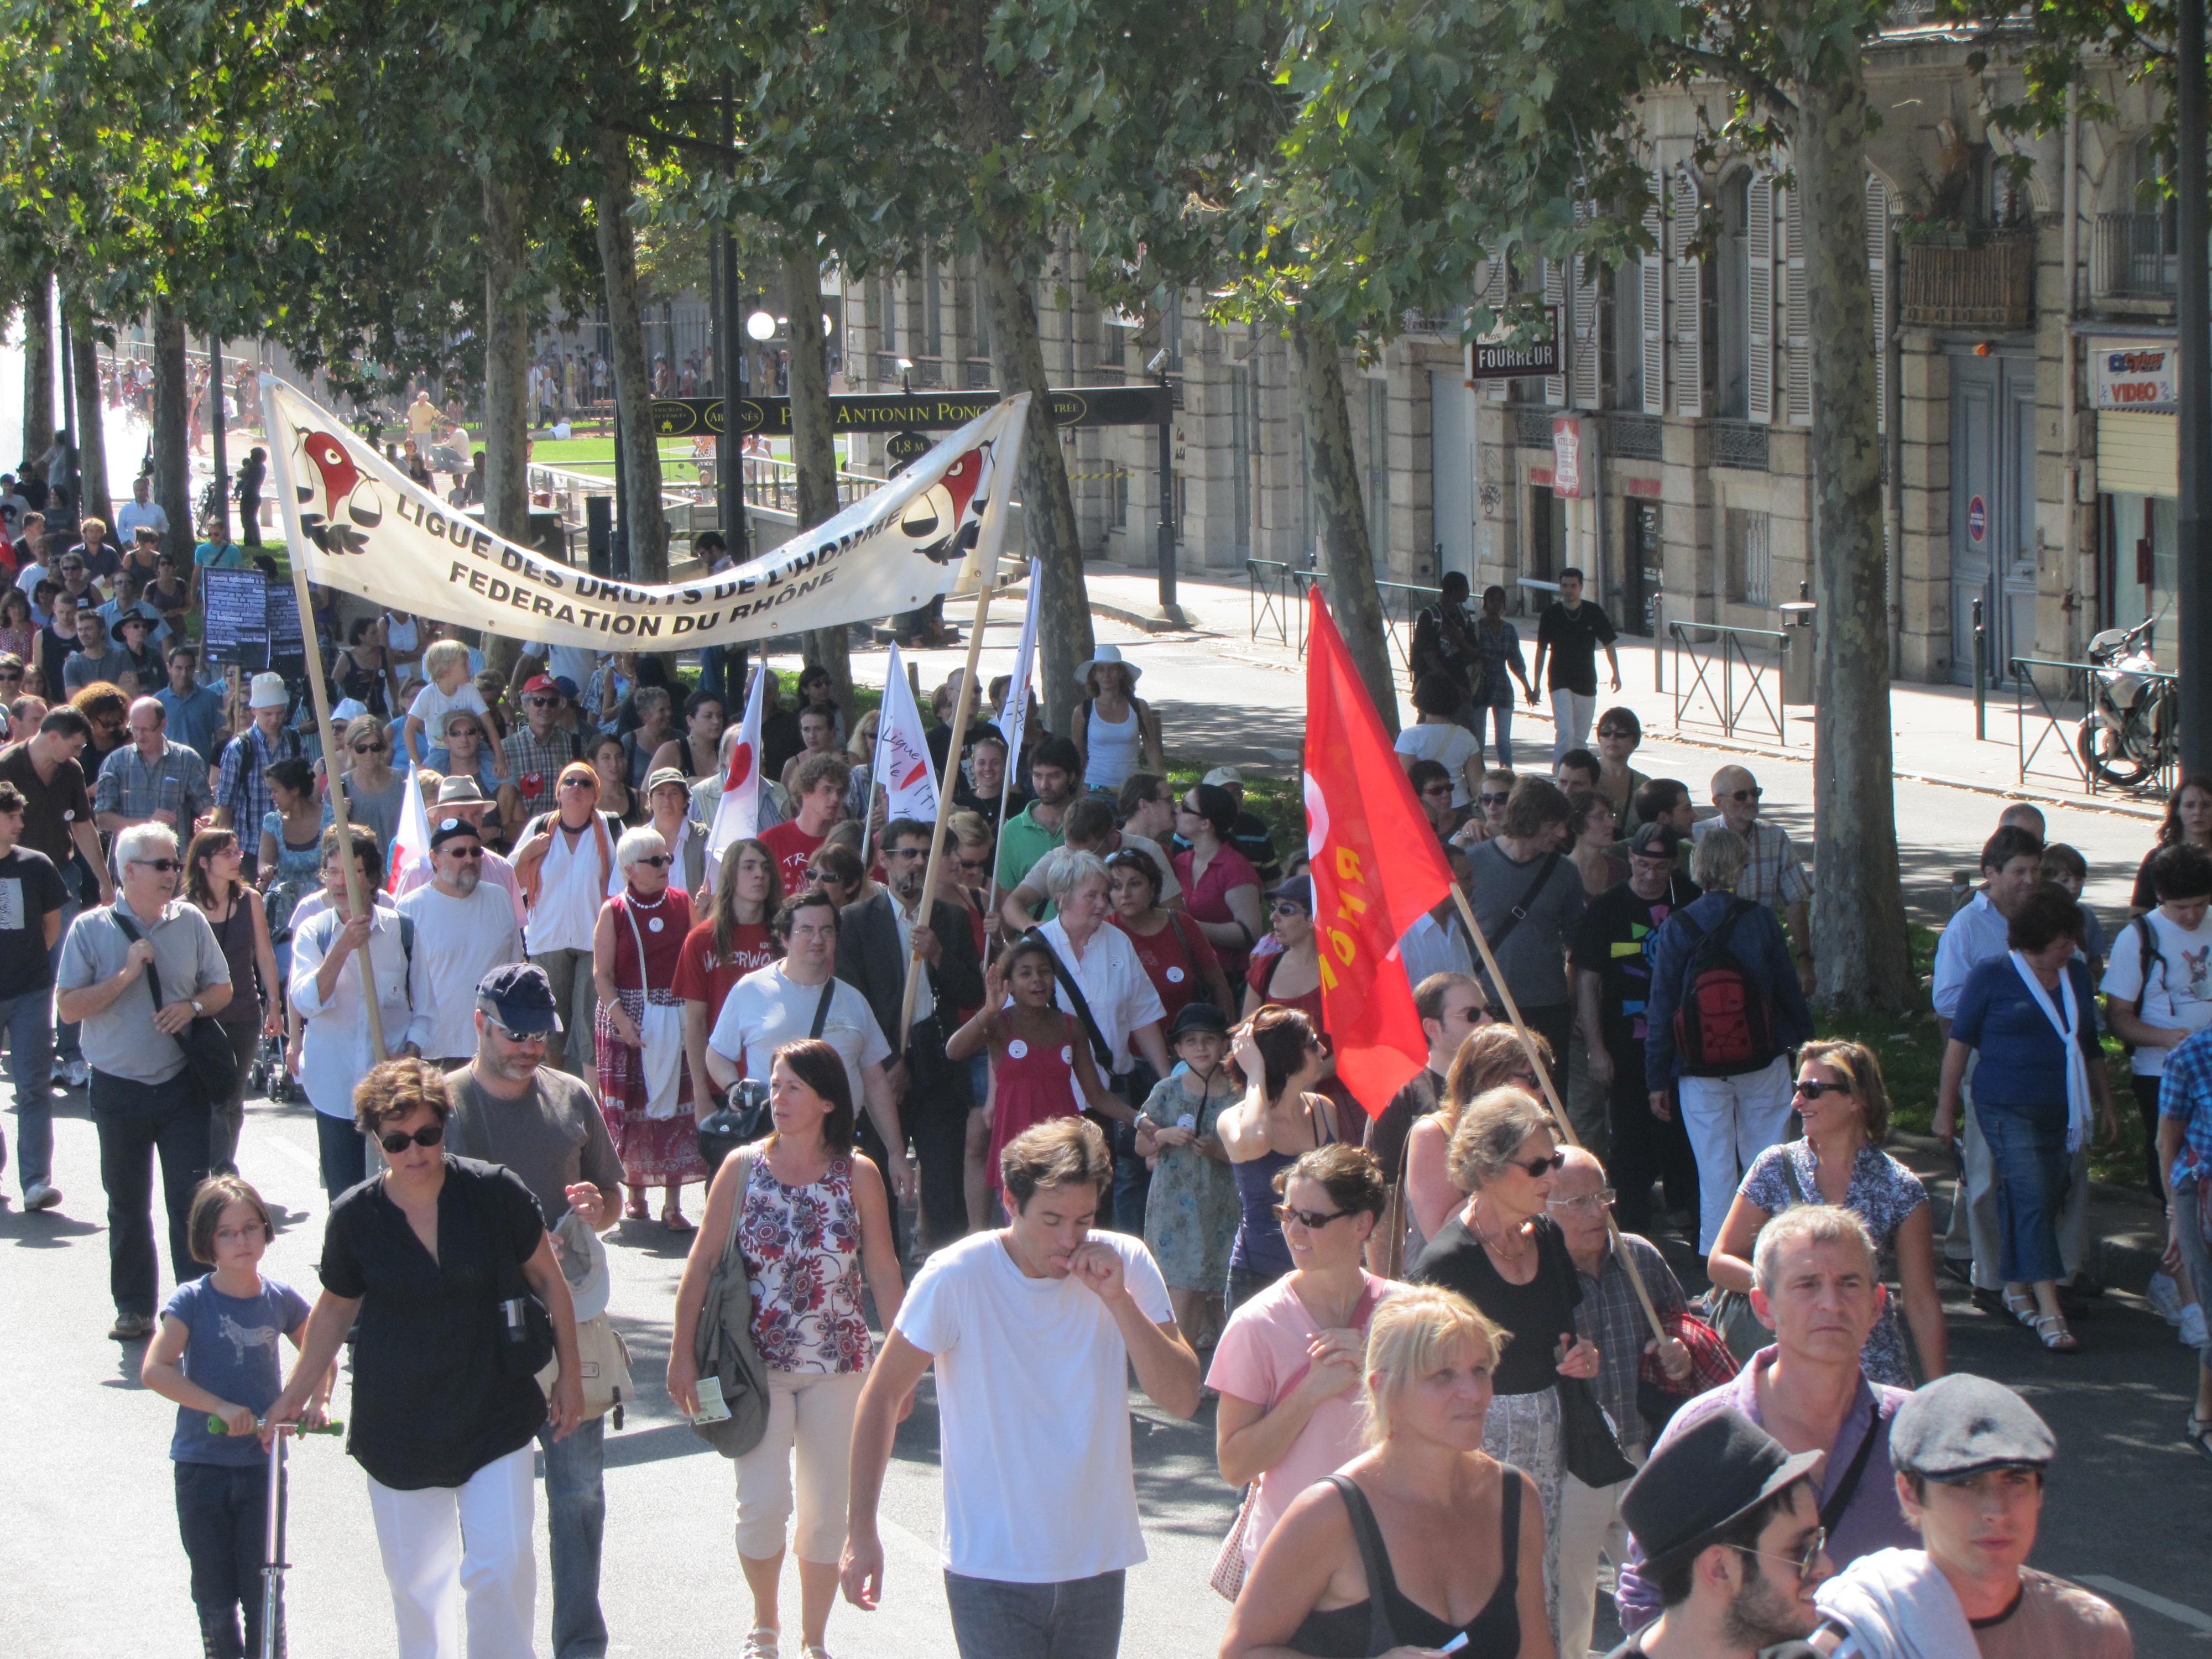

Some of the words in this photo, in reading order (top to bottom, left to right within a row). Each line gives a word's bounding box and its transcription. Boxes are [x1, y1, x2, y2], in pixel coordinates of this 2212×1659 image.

[2111, 382, 2158, 403] VIDEO
[895, 440, 911, 453] 1,8
[397, 493, 493, 560] LIGUE
[500, 545, 564, 588] DES
[714, 576, 756, 601] DE
[767, 506, 903, 588] L'HOMME
[228, 576, 254, 584] nationale
[449, 561, 662, 637] FEDERATION
[671, 612, 720, 635] DU
[729, 566, 838, 623] RHÔNE
[882, 726, 920, 760] Ligue
